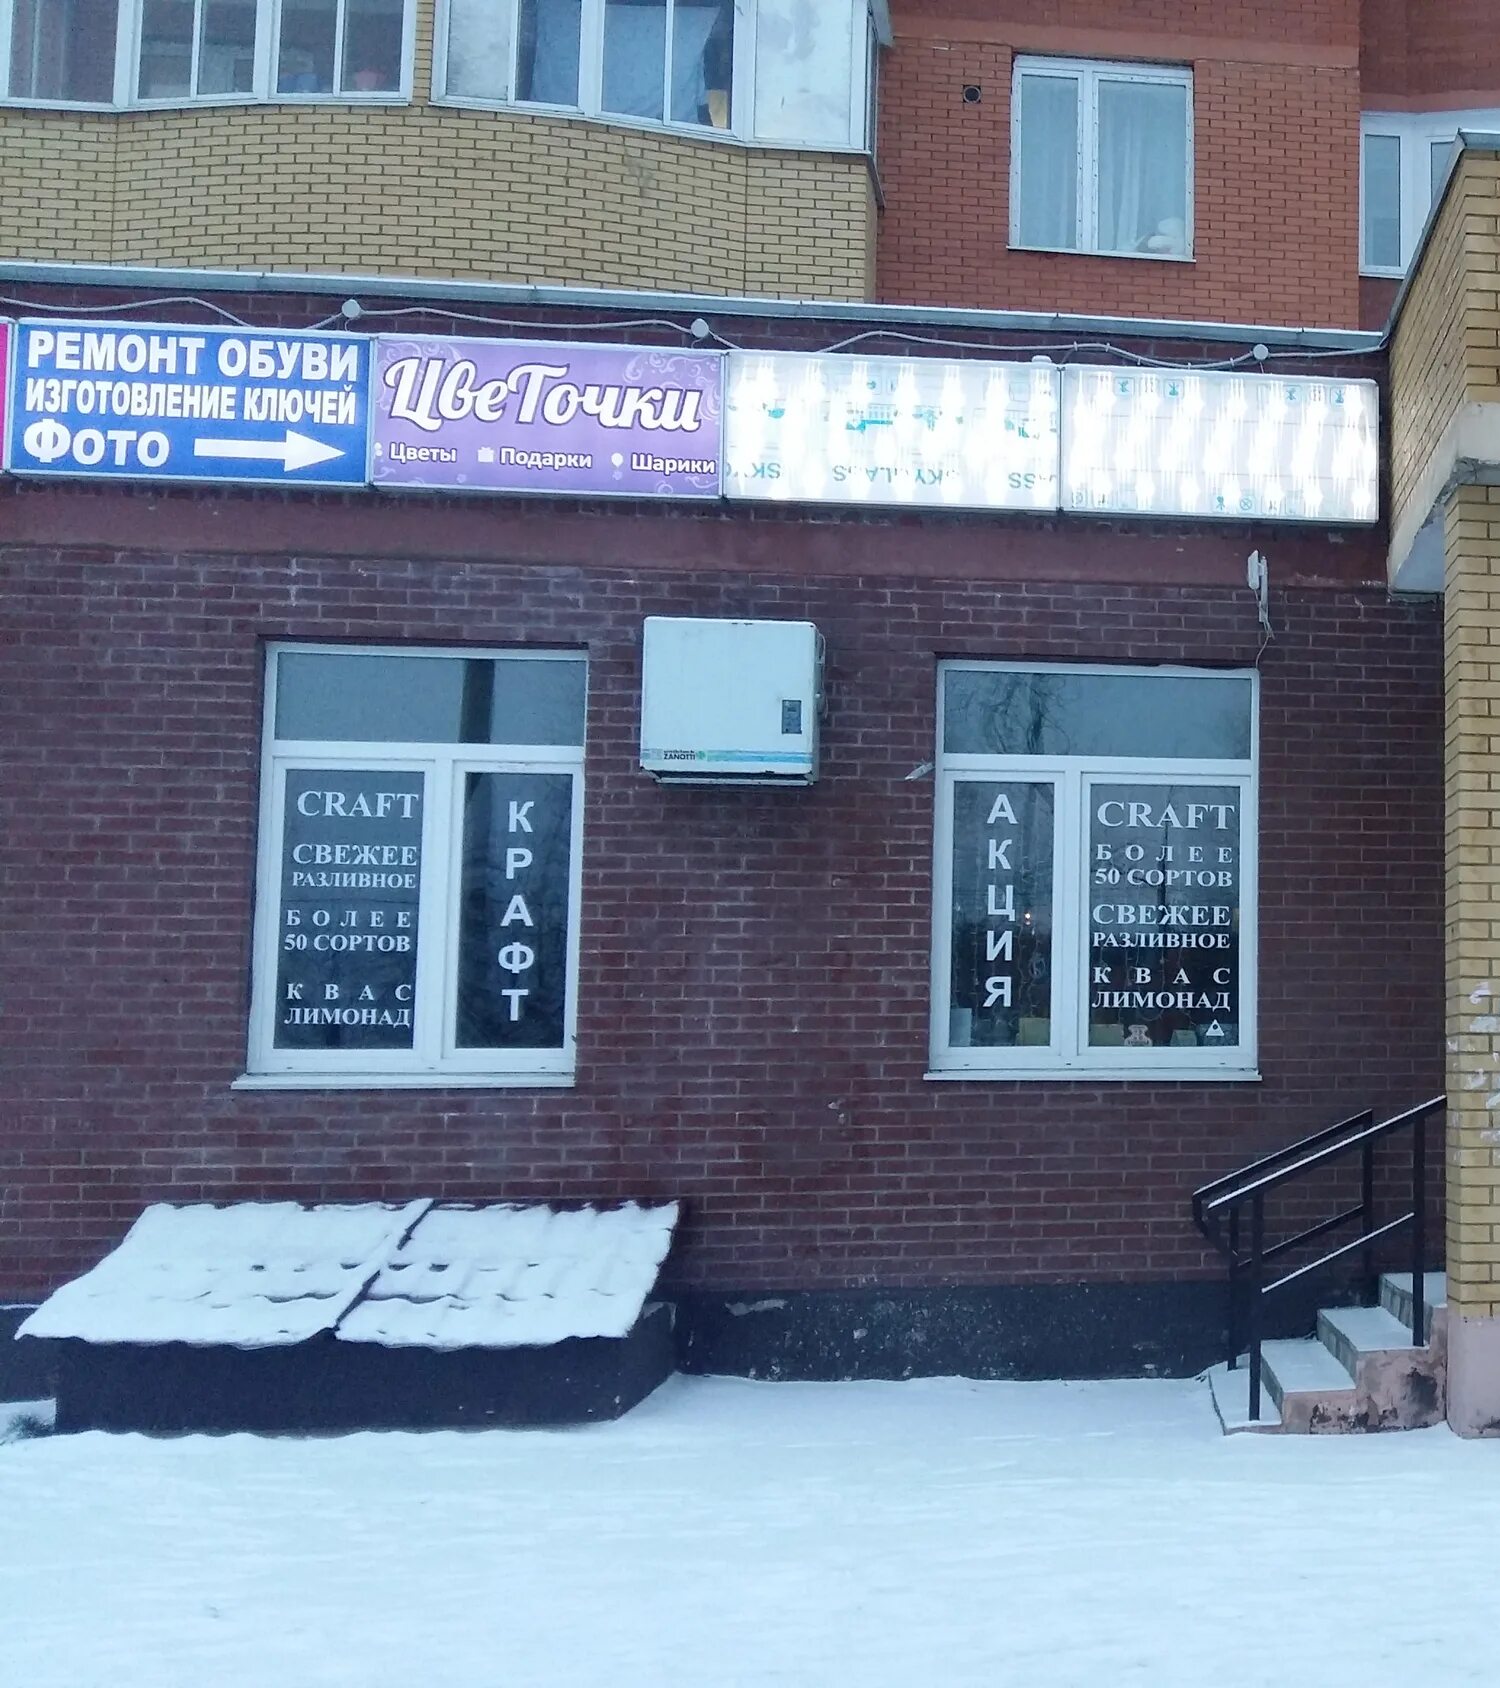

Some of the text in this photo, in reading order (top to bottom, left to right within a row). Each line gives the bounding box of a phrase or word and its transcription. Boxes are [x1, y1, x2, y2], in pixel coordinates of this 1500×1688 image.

[28, 330, 358, 382] РЕМОНТ ОБУВИ
[25, 377, 356, 425] ИЗГОТОВЛЕНИЕ КЛЮЧЕЙ
[383, 356, 703, 432] ЦвеТочки
[389, 443, 457, 463] Цветы
[499, 447, 593, 470] Подарки
[631, 453, 717, 476] Шарики
[297, 790, 419, 818] CRAFT
[1097, 801, 1235, 830] CRAFT
[293, 844, 417, 866] СВЕЖЕЕ
[1095, 844, 1233, 864] БОЛЕЕ
[292, 872, 416, 889] РАЗЛИВНОЕ
[1095, 868, 1233, 887] 50 СОРТОВ
[498, 800, 535, 1021] КРАФТ
[983, 794, 1018, 1007] АКЦИЯ
[286, 909, 411, 928] БОЛЕЕ
[1092, 904, 1231, 926] СВЕЖЕЕ
[284, 934, 411, 952] 50 СОРТОВ
[1092, 932, 1231, 949] РАЗЛИВНОЕ
[1092, 967, 1231, 984] КВАС
[285, 983, 412, 1001] КВАС
[1091, 991, 1231, 1012] ЛИМОНАД
[284, 1008, 411, 1028] ЛИМОНАД
